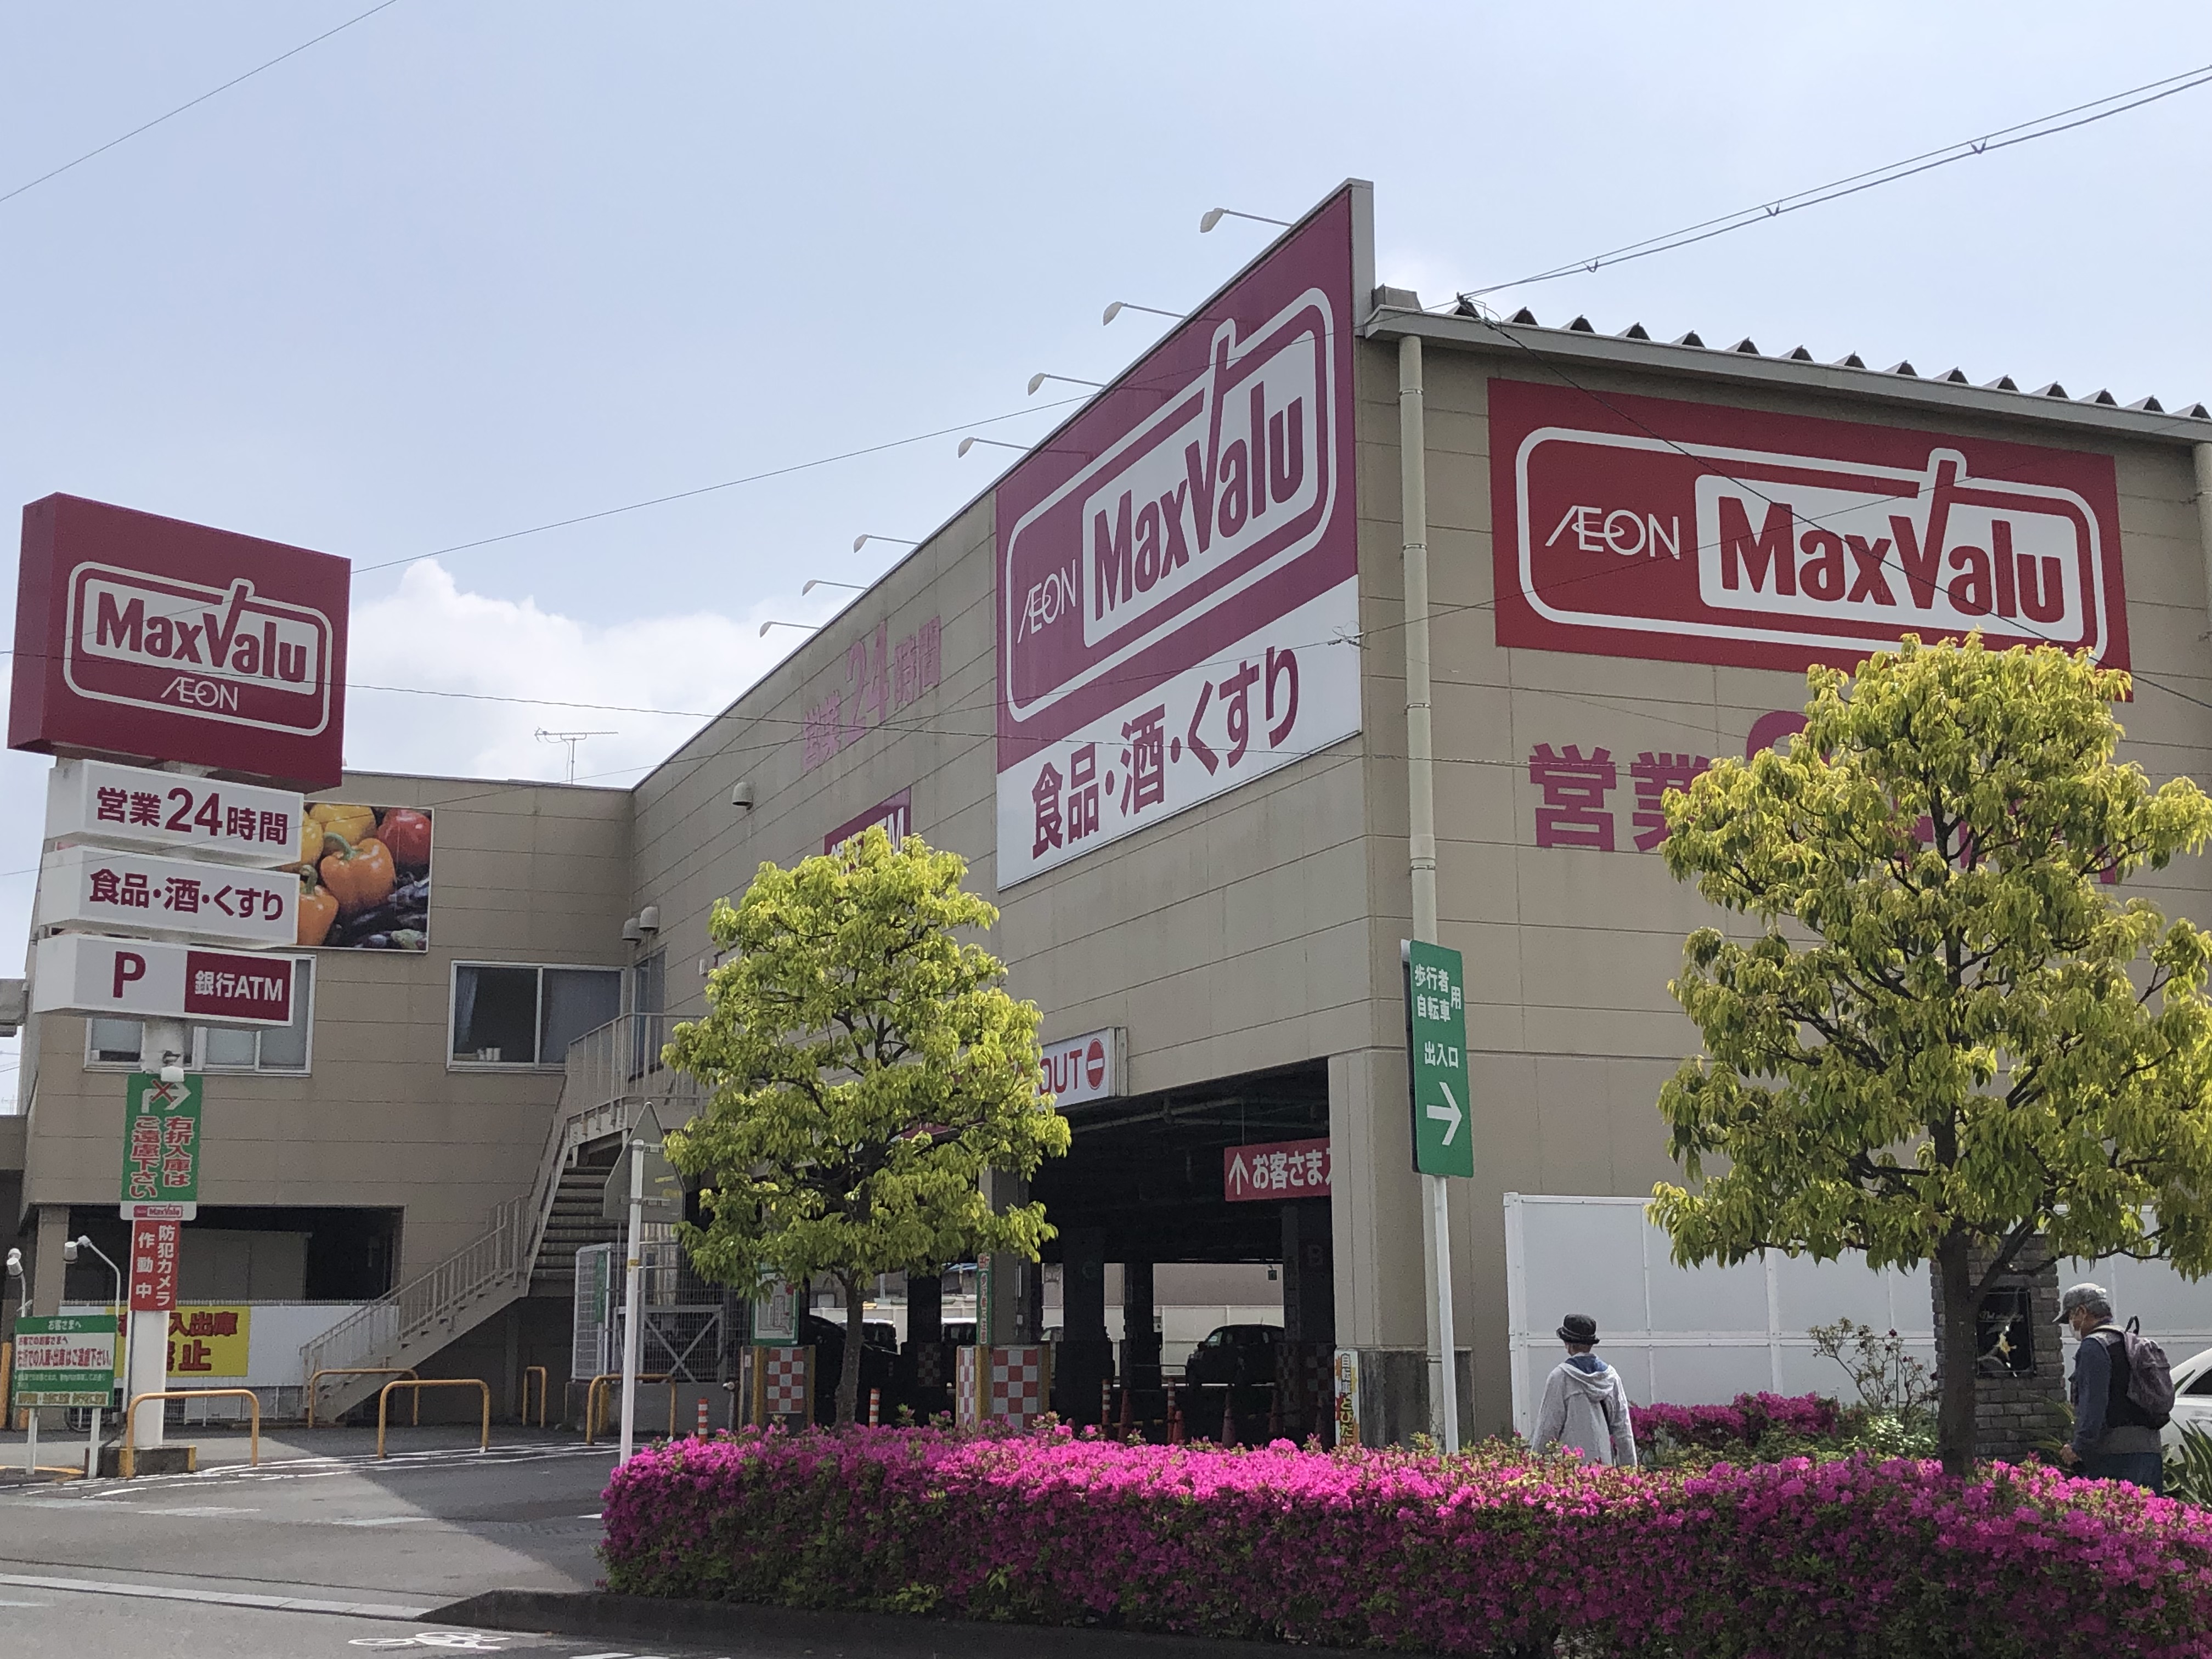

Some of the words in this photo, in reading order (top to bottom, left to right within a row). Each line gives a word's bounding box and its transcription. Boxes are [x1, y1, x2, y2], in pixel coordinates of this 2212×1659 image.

[1095, 334, 1304, 622] MaxValu
[1718, 460, 2065, 624] MaxValu
[96, 585, 307, 682] MaxValu
[1031, 646, 1299, 860] 食品・酒・くすり
[97, 787, 287, 845] 営業24時間
[89, 868, 283, 921] 食品・酒・くすり
[112, 951, 146, 998] P
[195, 970, 283, 1002] 銀行ATM
[1415, 963, 1449, 993] 歩行者
[1451, 986, 1461, 1009] 用
[1417, 994, 1451, 1022] 自転車
[1039, 1049, 1082, 1095] OUT
[1424, 1041, 1459, 1068] 出入口
[129, 1116, 161, 1199] ご遠慮下さい
[163, 1116, 194, 1188] 右折入庫は
[136, 1232, 155, 1299] 作動中
[156, 1225, 175, 1306] 防犯カメラ
